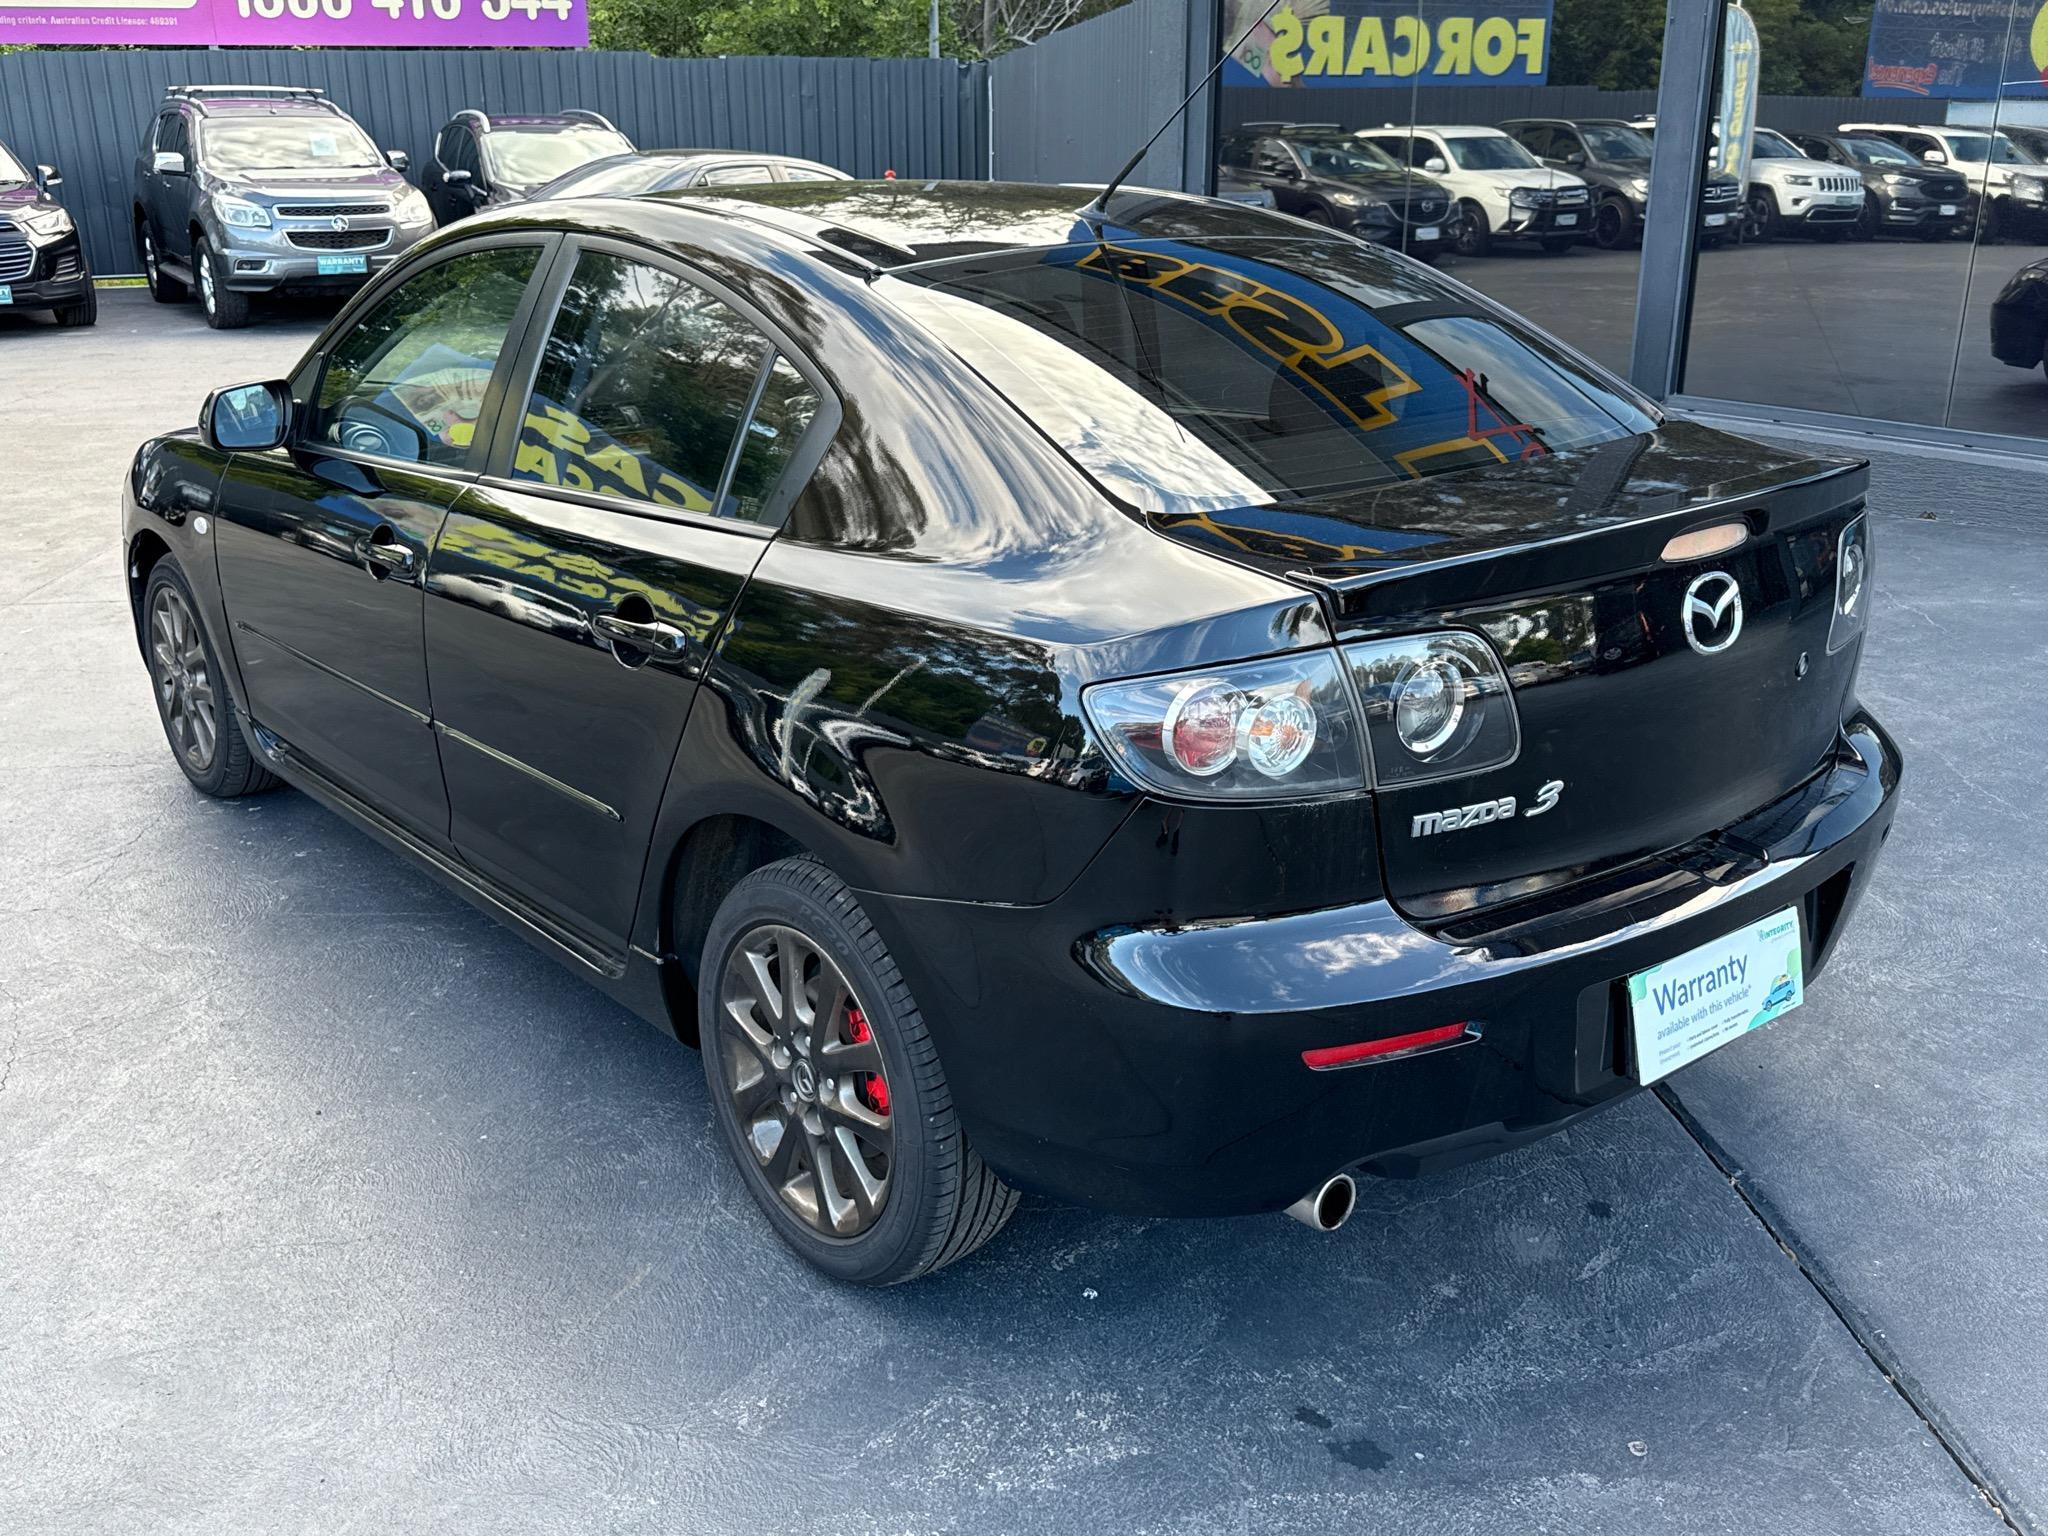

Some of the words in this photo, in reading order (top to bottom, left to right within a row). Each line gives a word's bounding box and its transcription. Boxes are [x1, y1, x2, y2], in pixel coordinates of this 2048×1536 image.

[50, 16, 90, 25] Australian
[91, 16, 114, 25] Credit
[1523, 779, 1564, 817] 3
[1652, 954, 1748, 1016] Warranty
[1657, 1017, 1690, 1040] available
[1691, 1007, 1709, 1023] with
[1709, 1000, 1723, 1015] this
